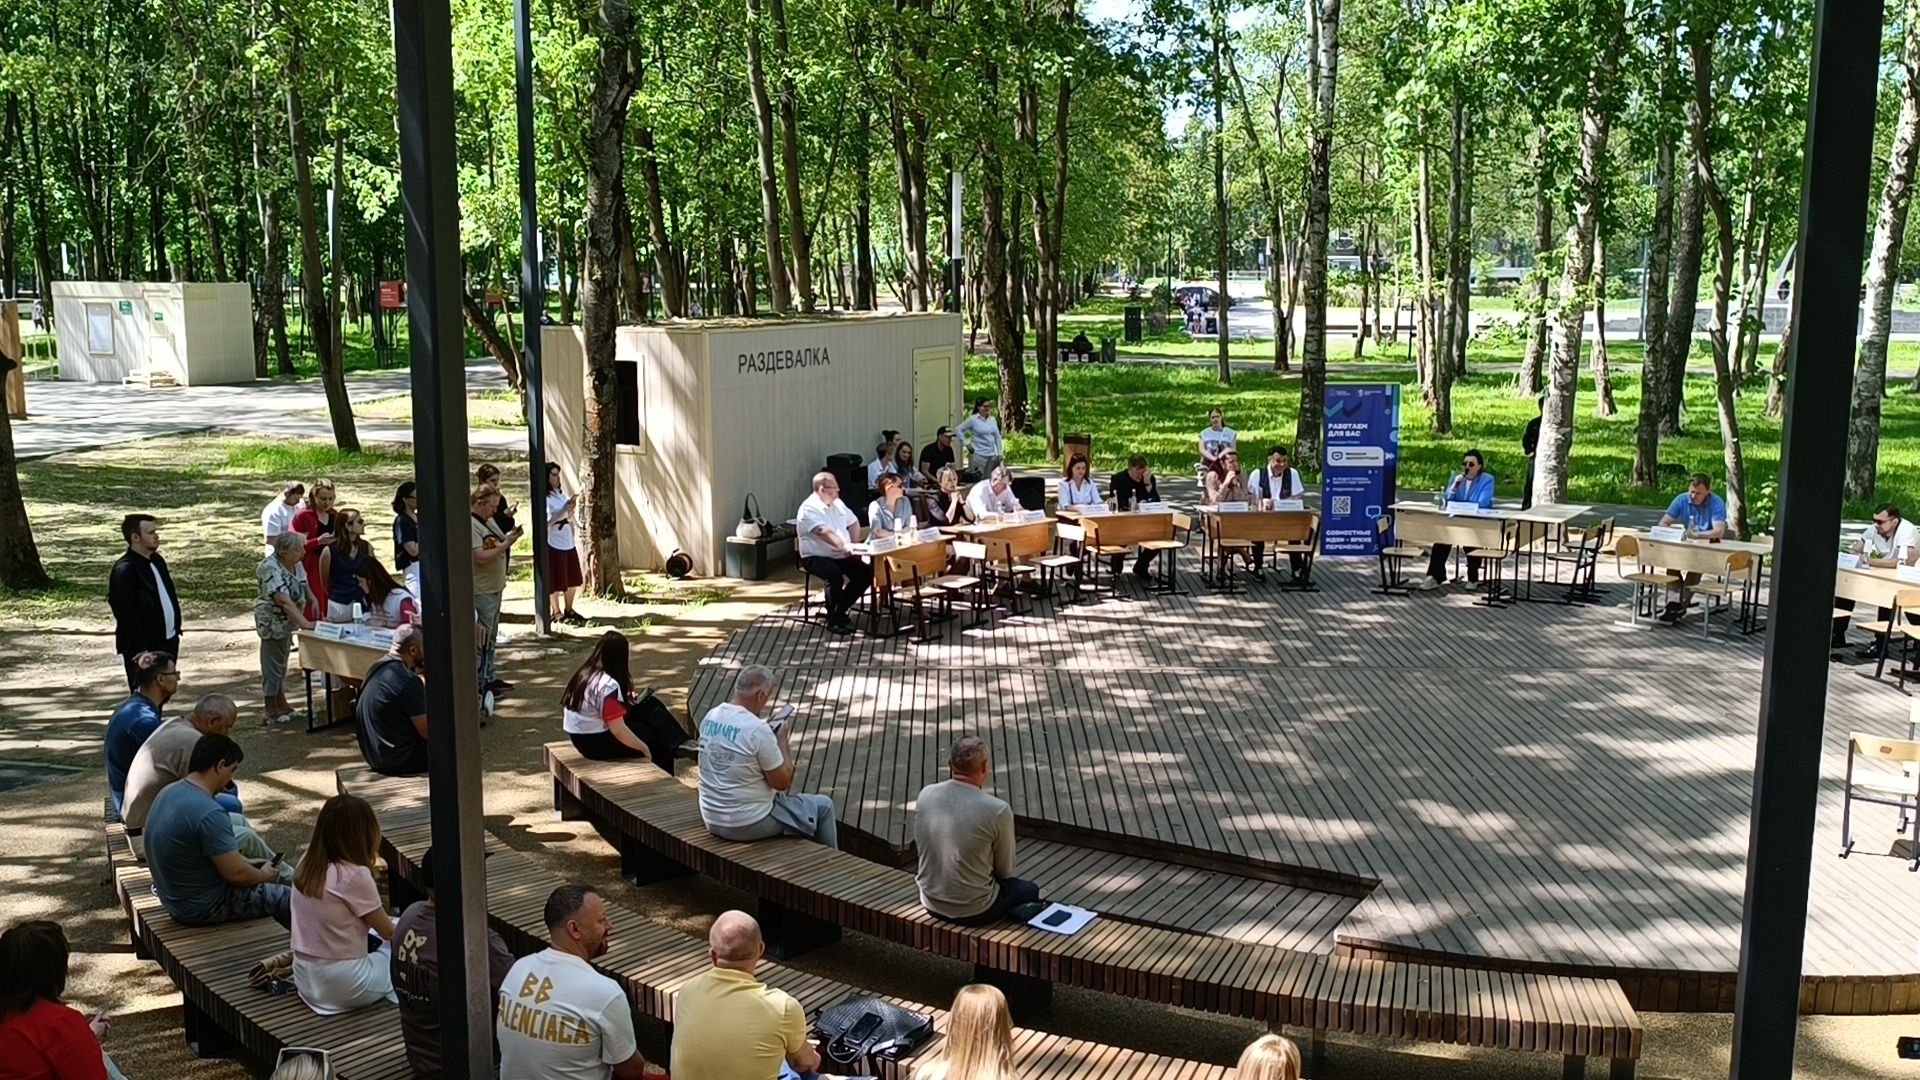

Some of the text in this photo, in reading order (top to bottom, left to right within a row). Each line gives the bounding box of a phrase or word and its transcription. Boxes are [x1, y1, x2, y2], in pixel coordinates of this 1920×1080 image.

[738, 347, 830, 375] РАЗДЕВАЛКА
[518, 971, 554, 1005] BB
[499, 995, 591, 1045] ALENCIAGA
